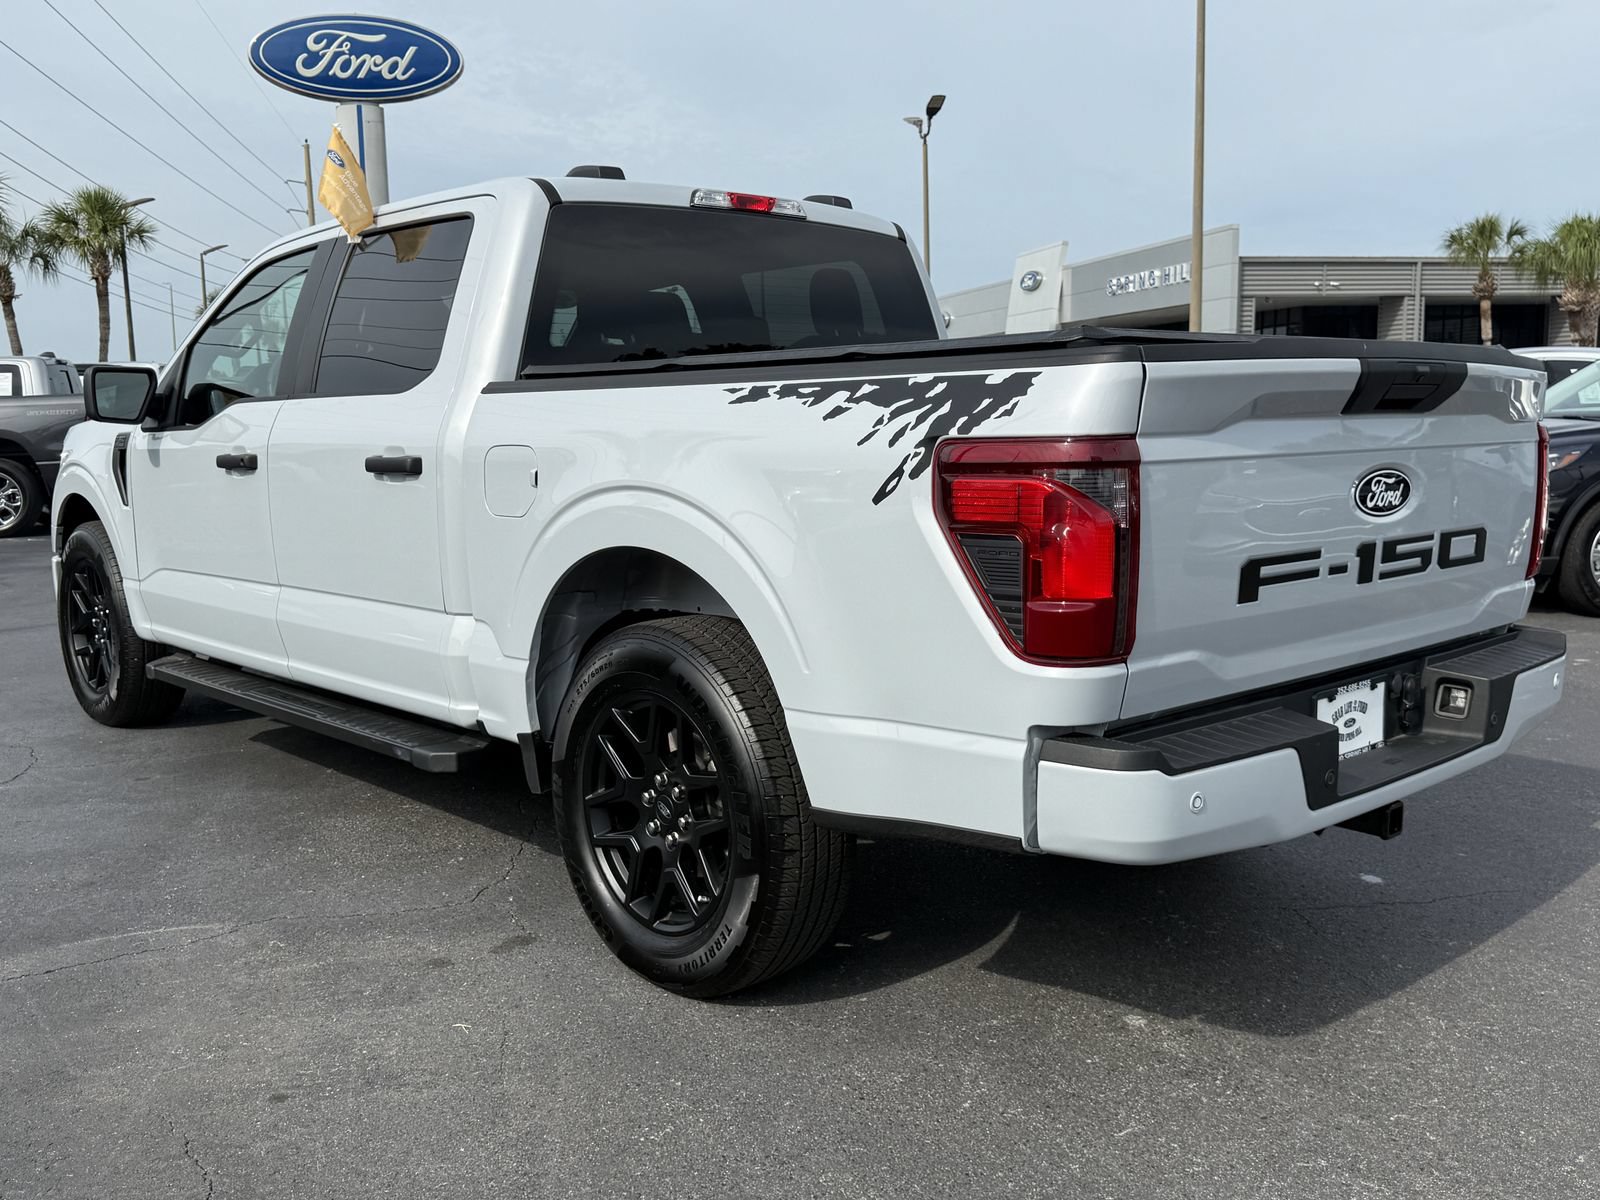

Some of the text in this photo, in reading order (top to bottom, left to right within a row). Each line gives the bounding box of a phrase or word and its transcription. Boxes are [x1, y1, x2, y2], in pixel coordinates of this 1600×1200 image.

[295, 29, 418, 81] Ford
[1105, 269, 1161, 297] SPRING
[1366, 476, 1404, 508] Ford
[1236, 526, 1488, 605] F-150
[678, 923, 733, 976] TERRITORY
